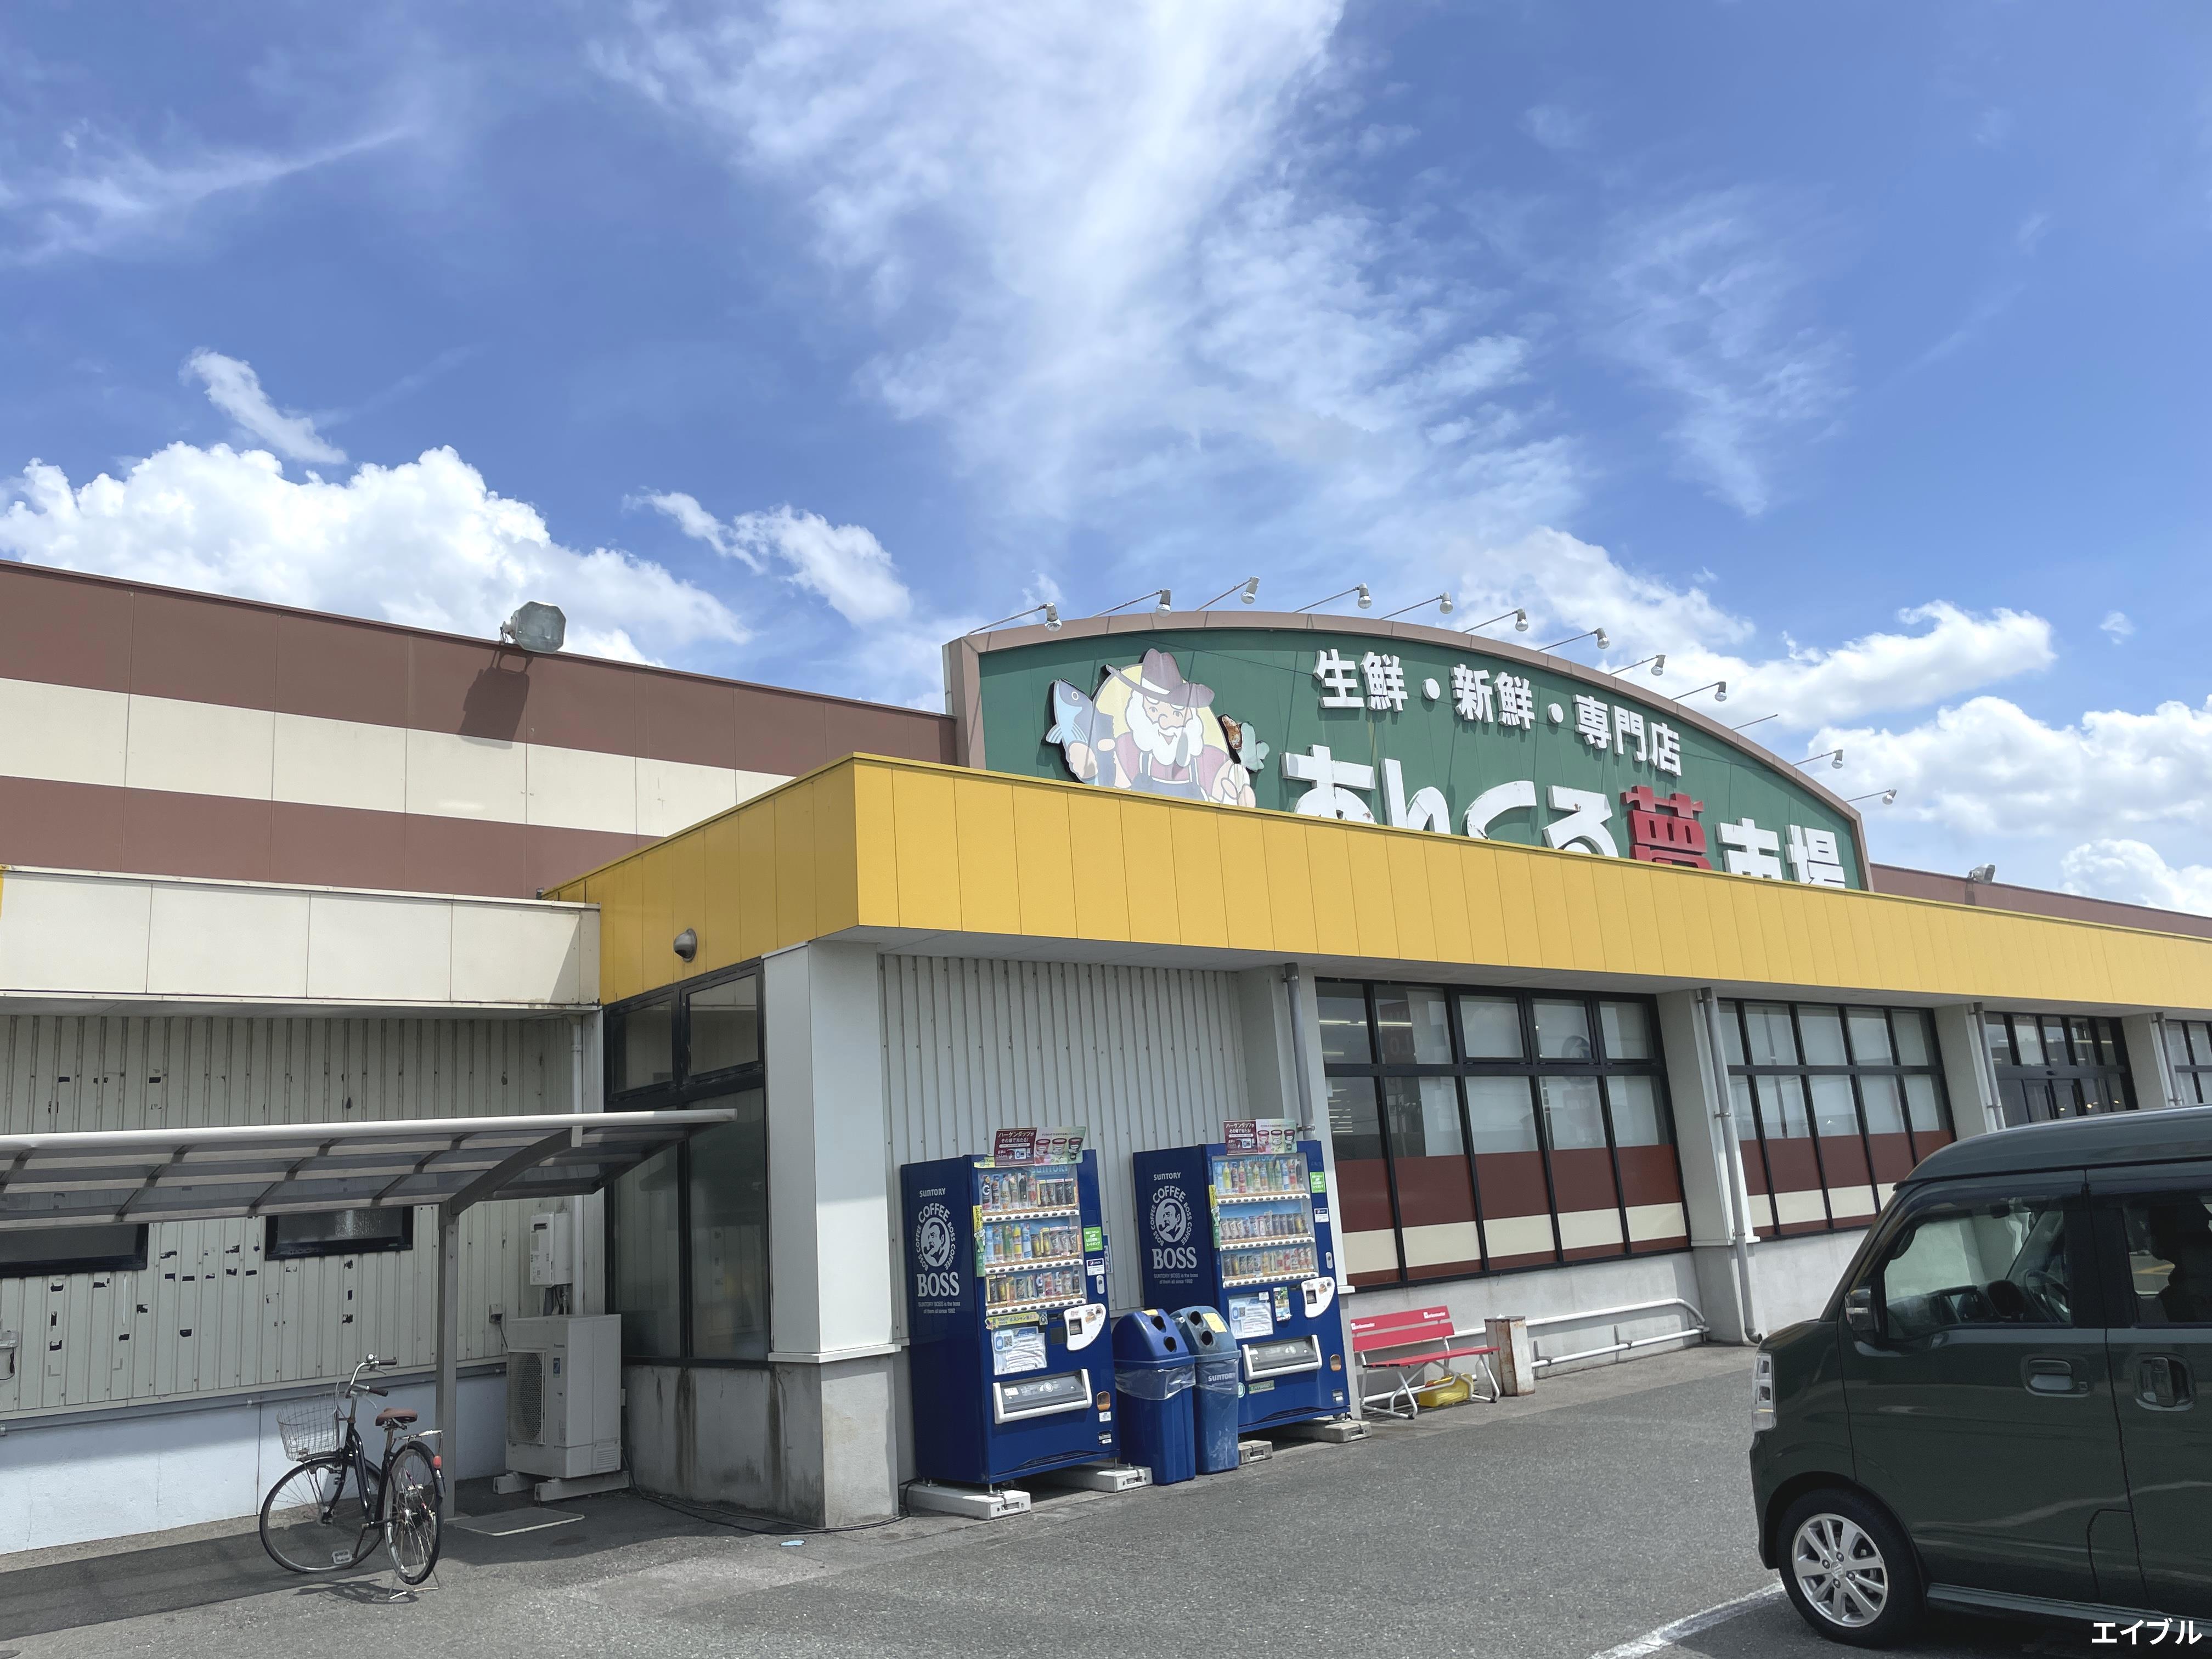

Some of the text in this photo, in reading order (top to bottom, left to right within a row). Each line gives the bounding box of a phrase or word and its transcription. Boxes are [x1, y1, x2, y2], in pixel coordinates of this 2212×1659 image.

[1313, 648, 1682, 777] 生鮮・新鮮・専門店
[1153, 1172, 1181, 1181] SUNTORY
[919, 1188, 946, 1198] SUNTORY
[1153, 1185, 1186, 1204] COFFEE
[918, 1203, 950, 1223] COFFEE
[1180, 1202, 1192, 1245] BOSS COFFEE
[944, 1221, 956, 1270] BOSS COFFEE
[1153, 1231, 1164, 1246] BOSS
[918, 1254, 928, 1271] BOSS
[1152, 1246, 1197, 1269] BOSS
[916, 1272, 960, 1297] BOSS
[1208, 1373, 1235, 1382] SUNTORY
